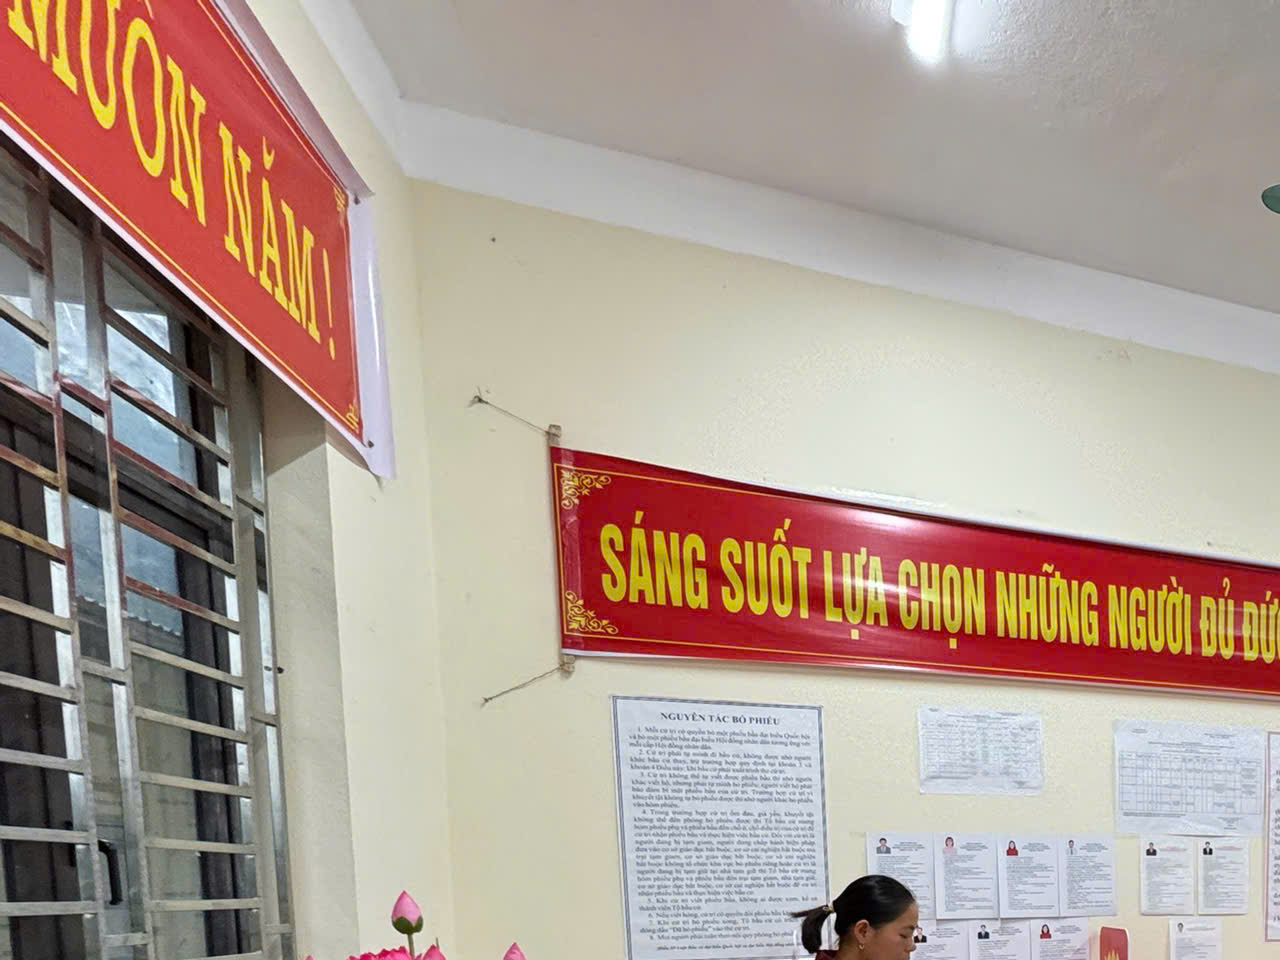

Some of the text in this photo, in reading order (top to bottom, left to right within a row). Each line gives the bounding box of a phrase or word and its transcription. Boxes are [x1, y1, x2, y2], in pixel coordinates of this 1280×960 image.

[219, 121, 336, 360] NĂM!
[600, 511, 708, 609] SÁNG
[720, 518, 811, 619] SUỐT
[824, 547, 888, 639] LỰA
[898, 559, 986, 649] CHỌN
[996, 563, 1099, 646] NHỮNG
[1108, 576, 1192, 655] NGƯỜI
[1200, 577, 1234, 660] ĐỦ
